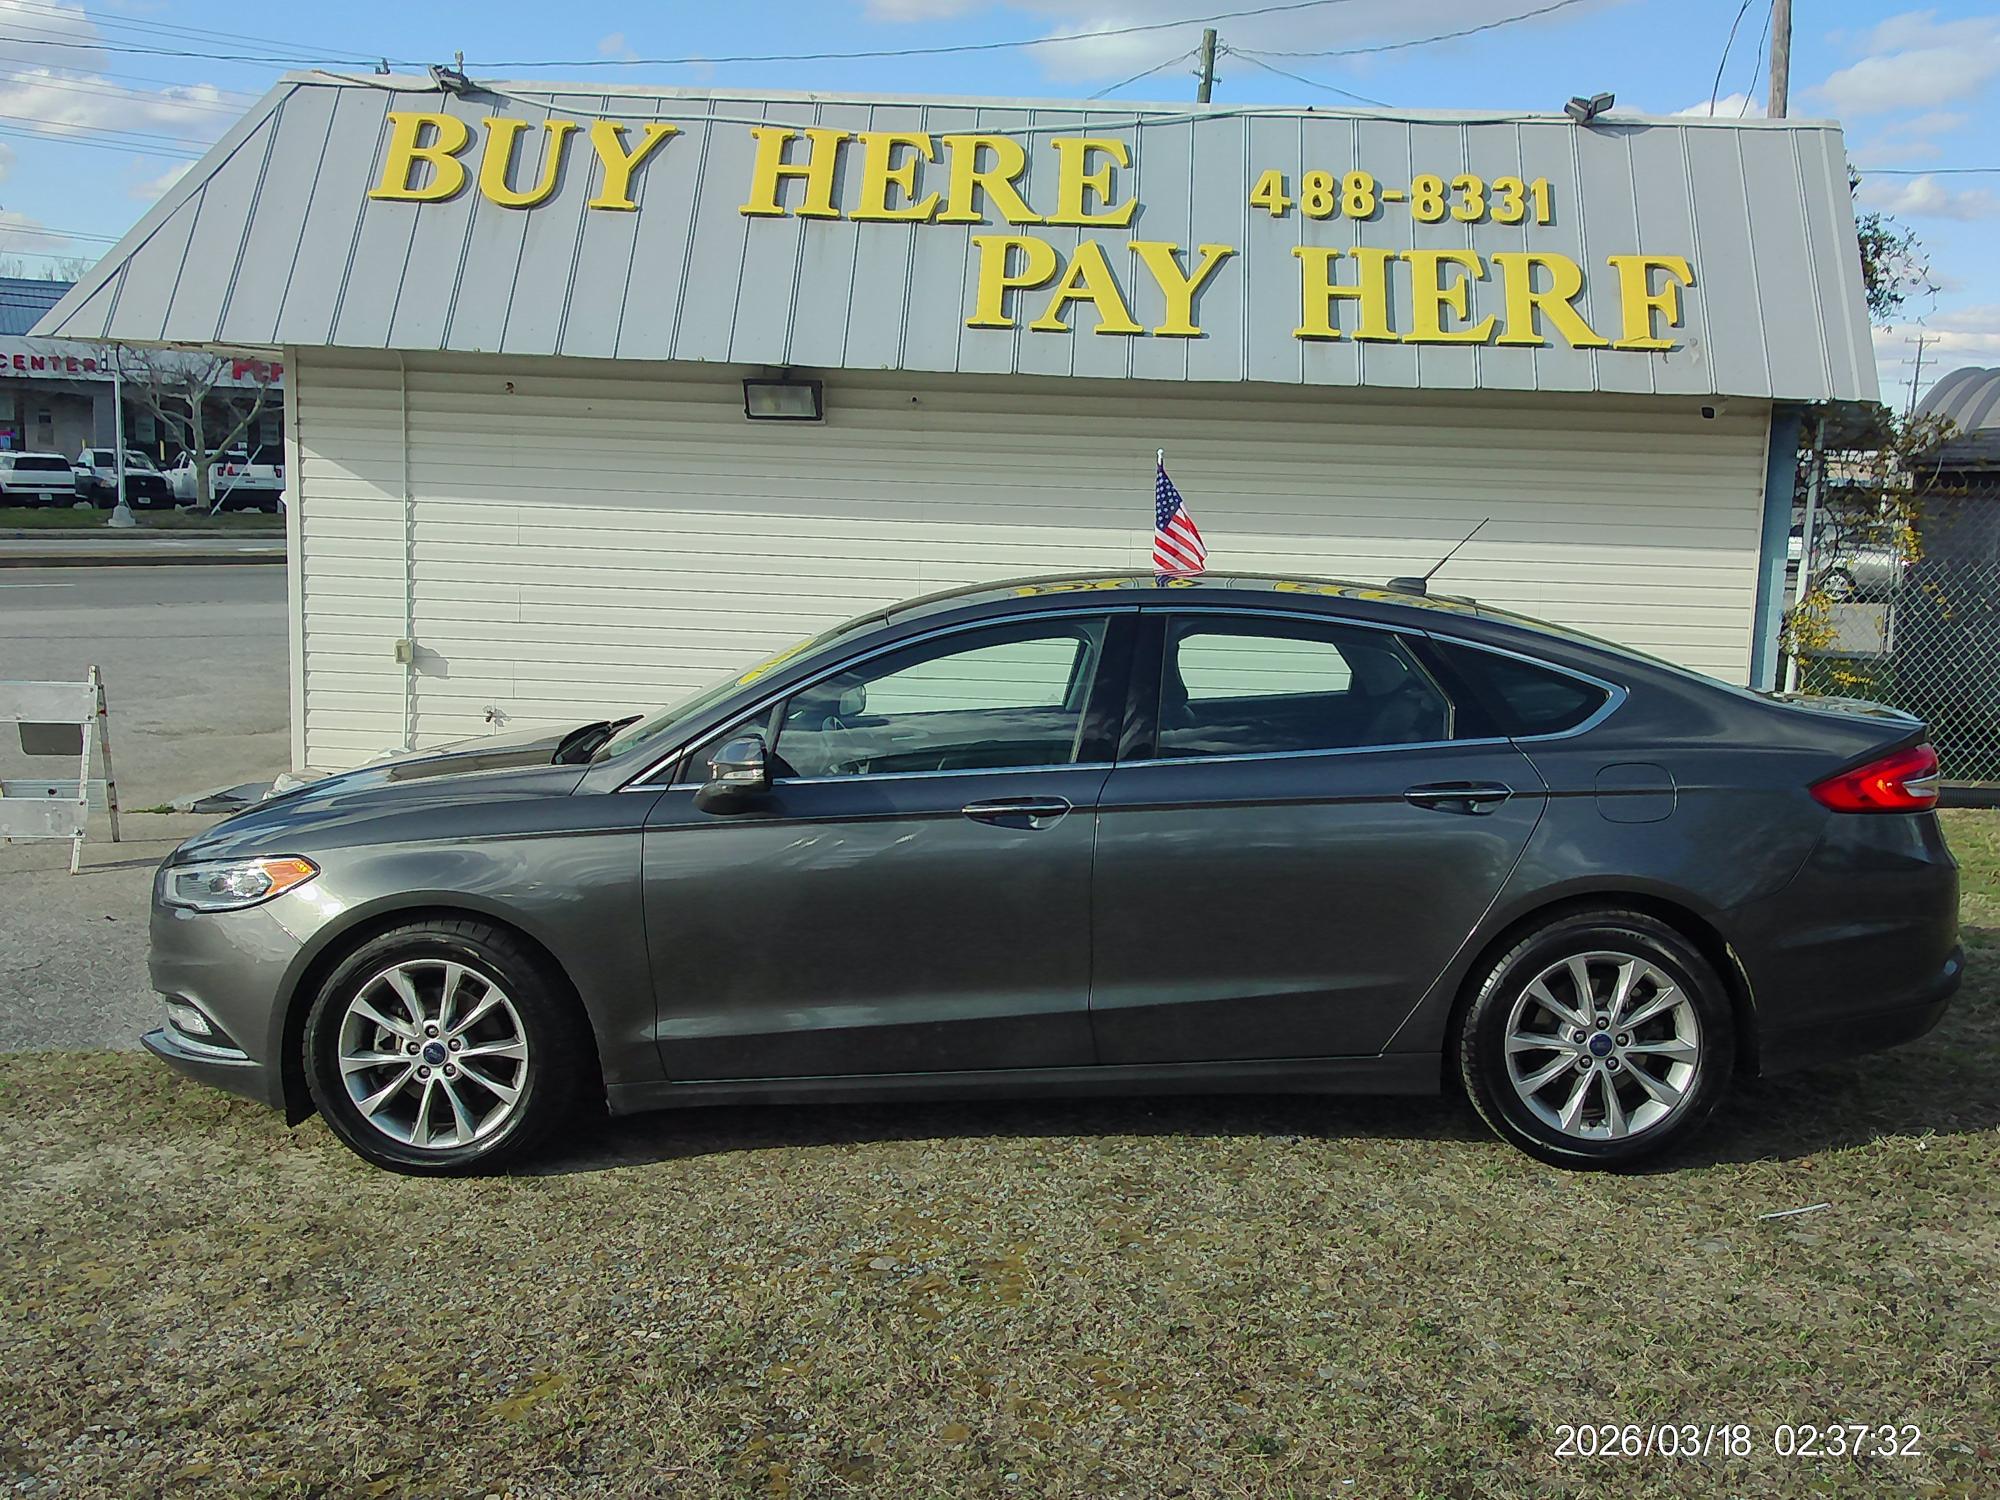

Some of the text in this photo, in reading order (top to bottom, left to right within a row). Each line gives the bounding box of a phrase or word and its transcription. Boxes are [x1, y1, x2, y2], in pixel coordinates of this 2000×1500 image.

[368, 111, 1138, 226] BUY HERE
[1249, 170, 1551, 223] 488-8331
[965, 234, 1235, 336] PAY
